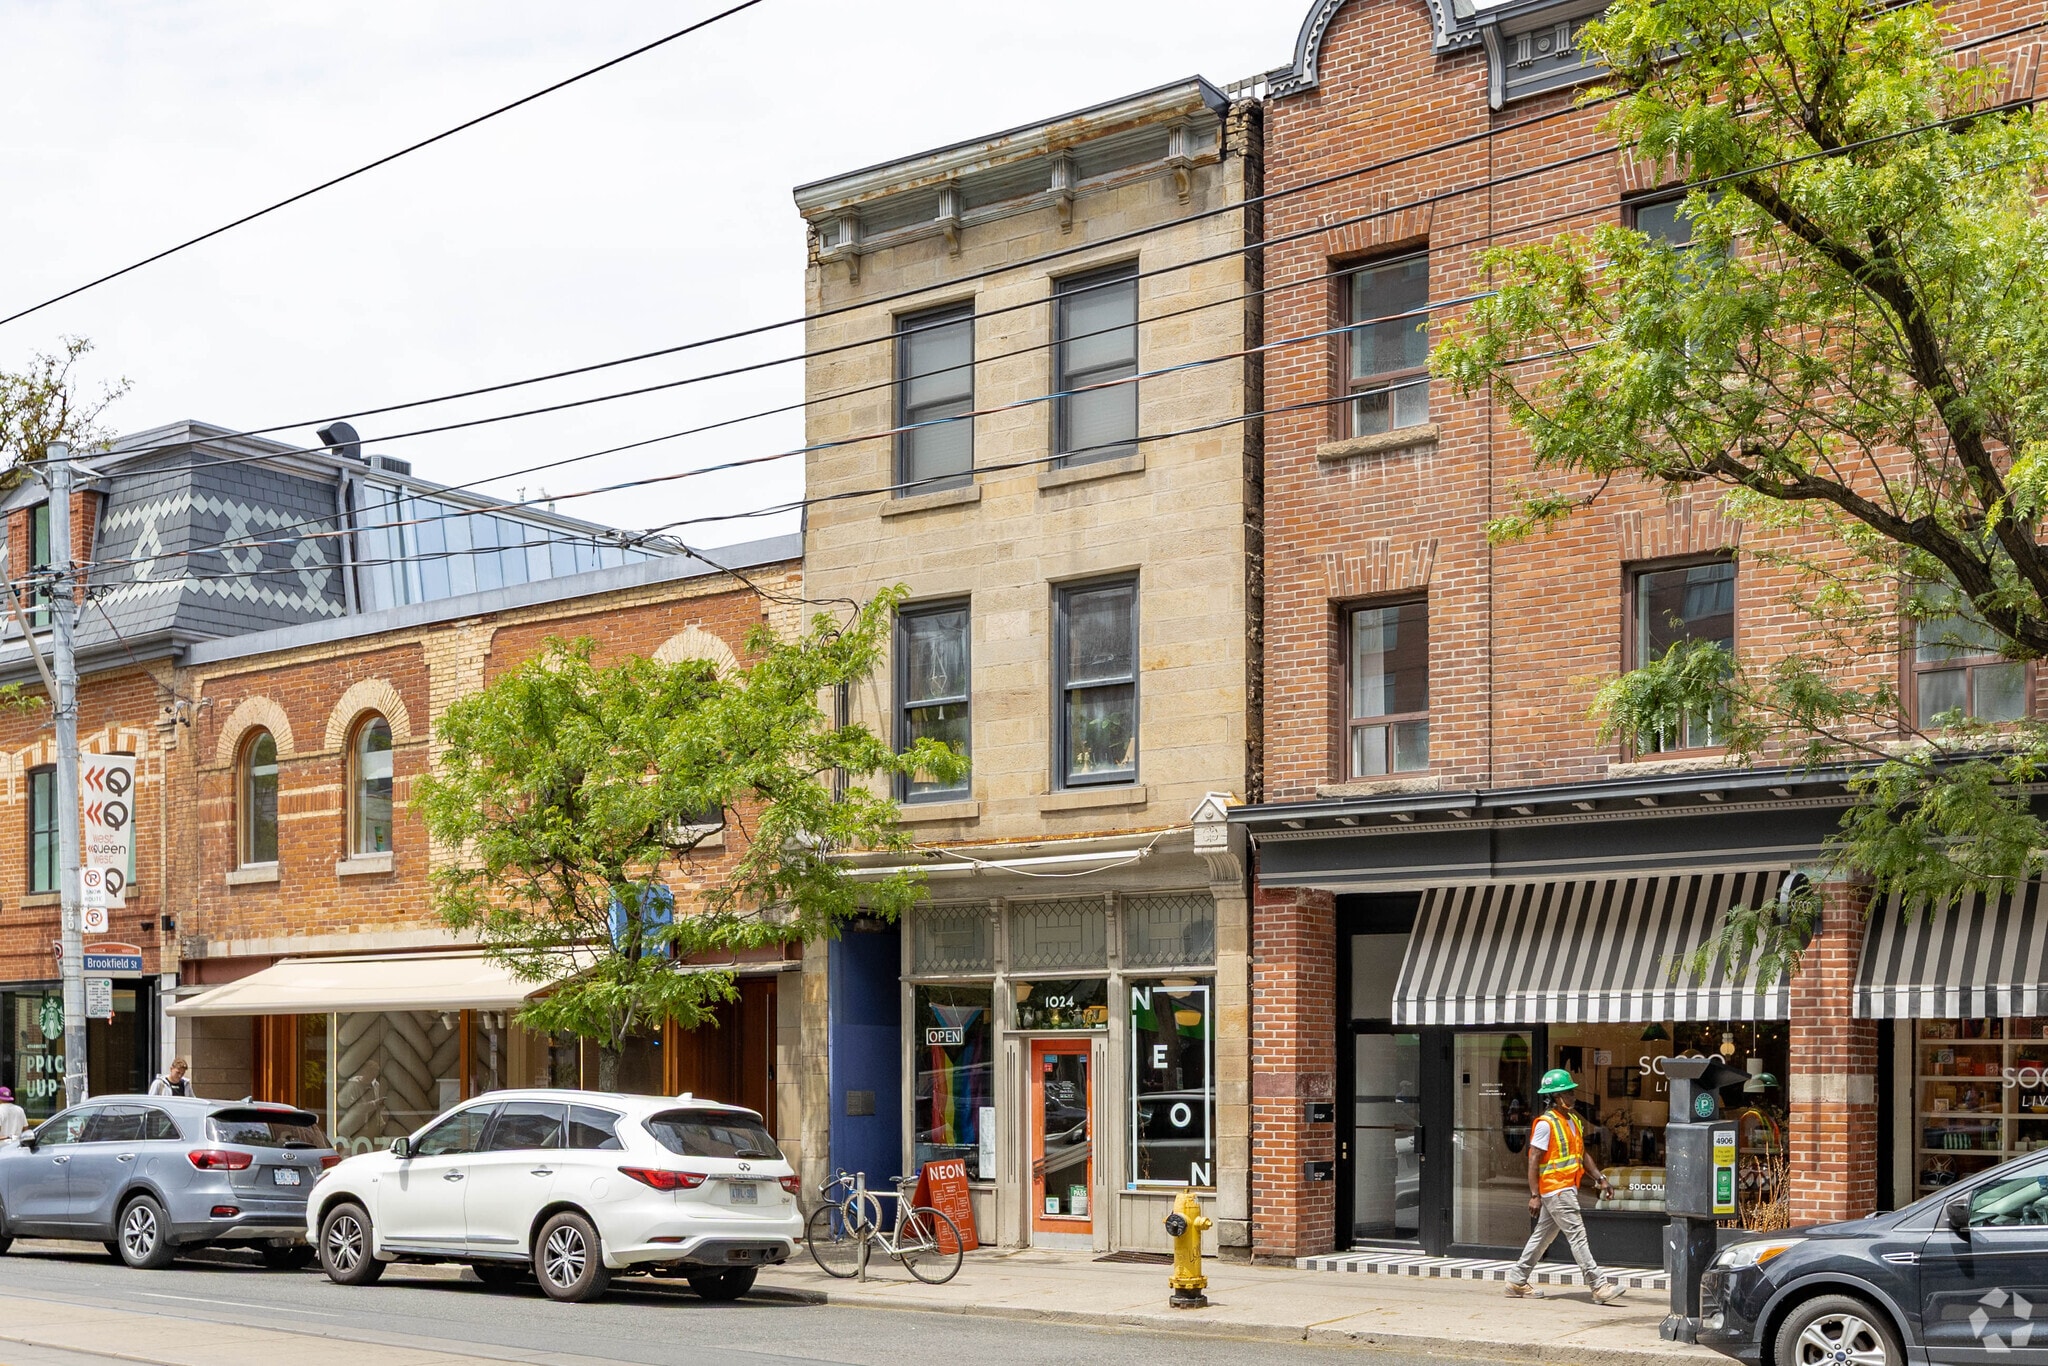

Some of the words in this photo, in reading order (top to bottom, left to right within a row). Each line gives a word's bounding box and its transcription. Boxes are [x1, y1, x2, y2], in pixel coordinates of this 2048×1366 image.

[105, 767, 131, 797] Q
[103, 801, 129, 831] Q
[92, 834, 114, 844] west
[93, 855, 114, 864] west
[87, 957, 129, 969] Brookfield
[130, 960, 138, 969] St
[1045, 995, 1075, 1008] 1024
[929, 1030, 960, 1043] OPEN
[1716, 1137, 1733, 1145] 4906
[929, 1163, 965, 1181] NEON
[1073, 1189, 1087, 1197] PASS
[1628, 1183, 1665, 1191] SOCCOLI
